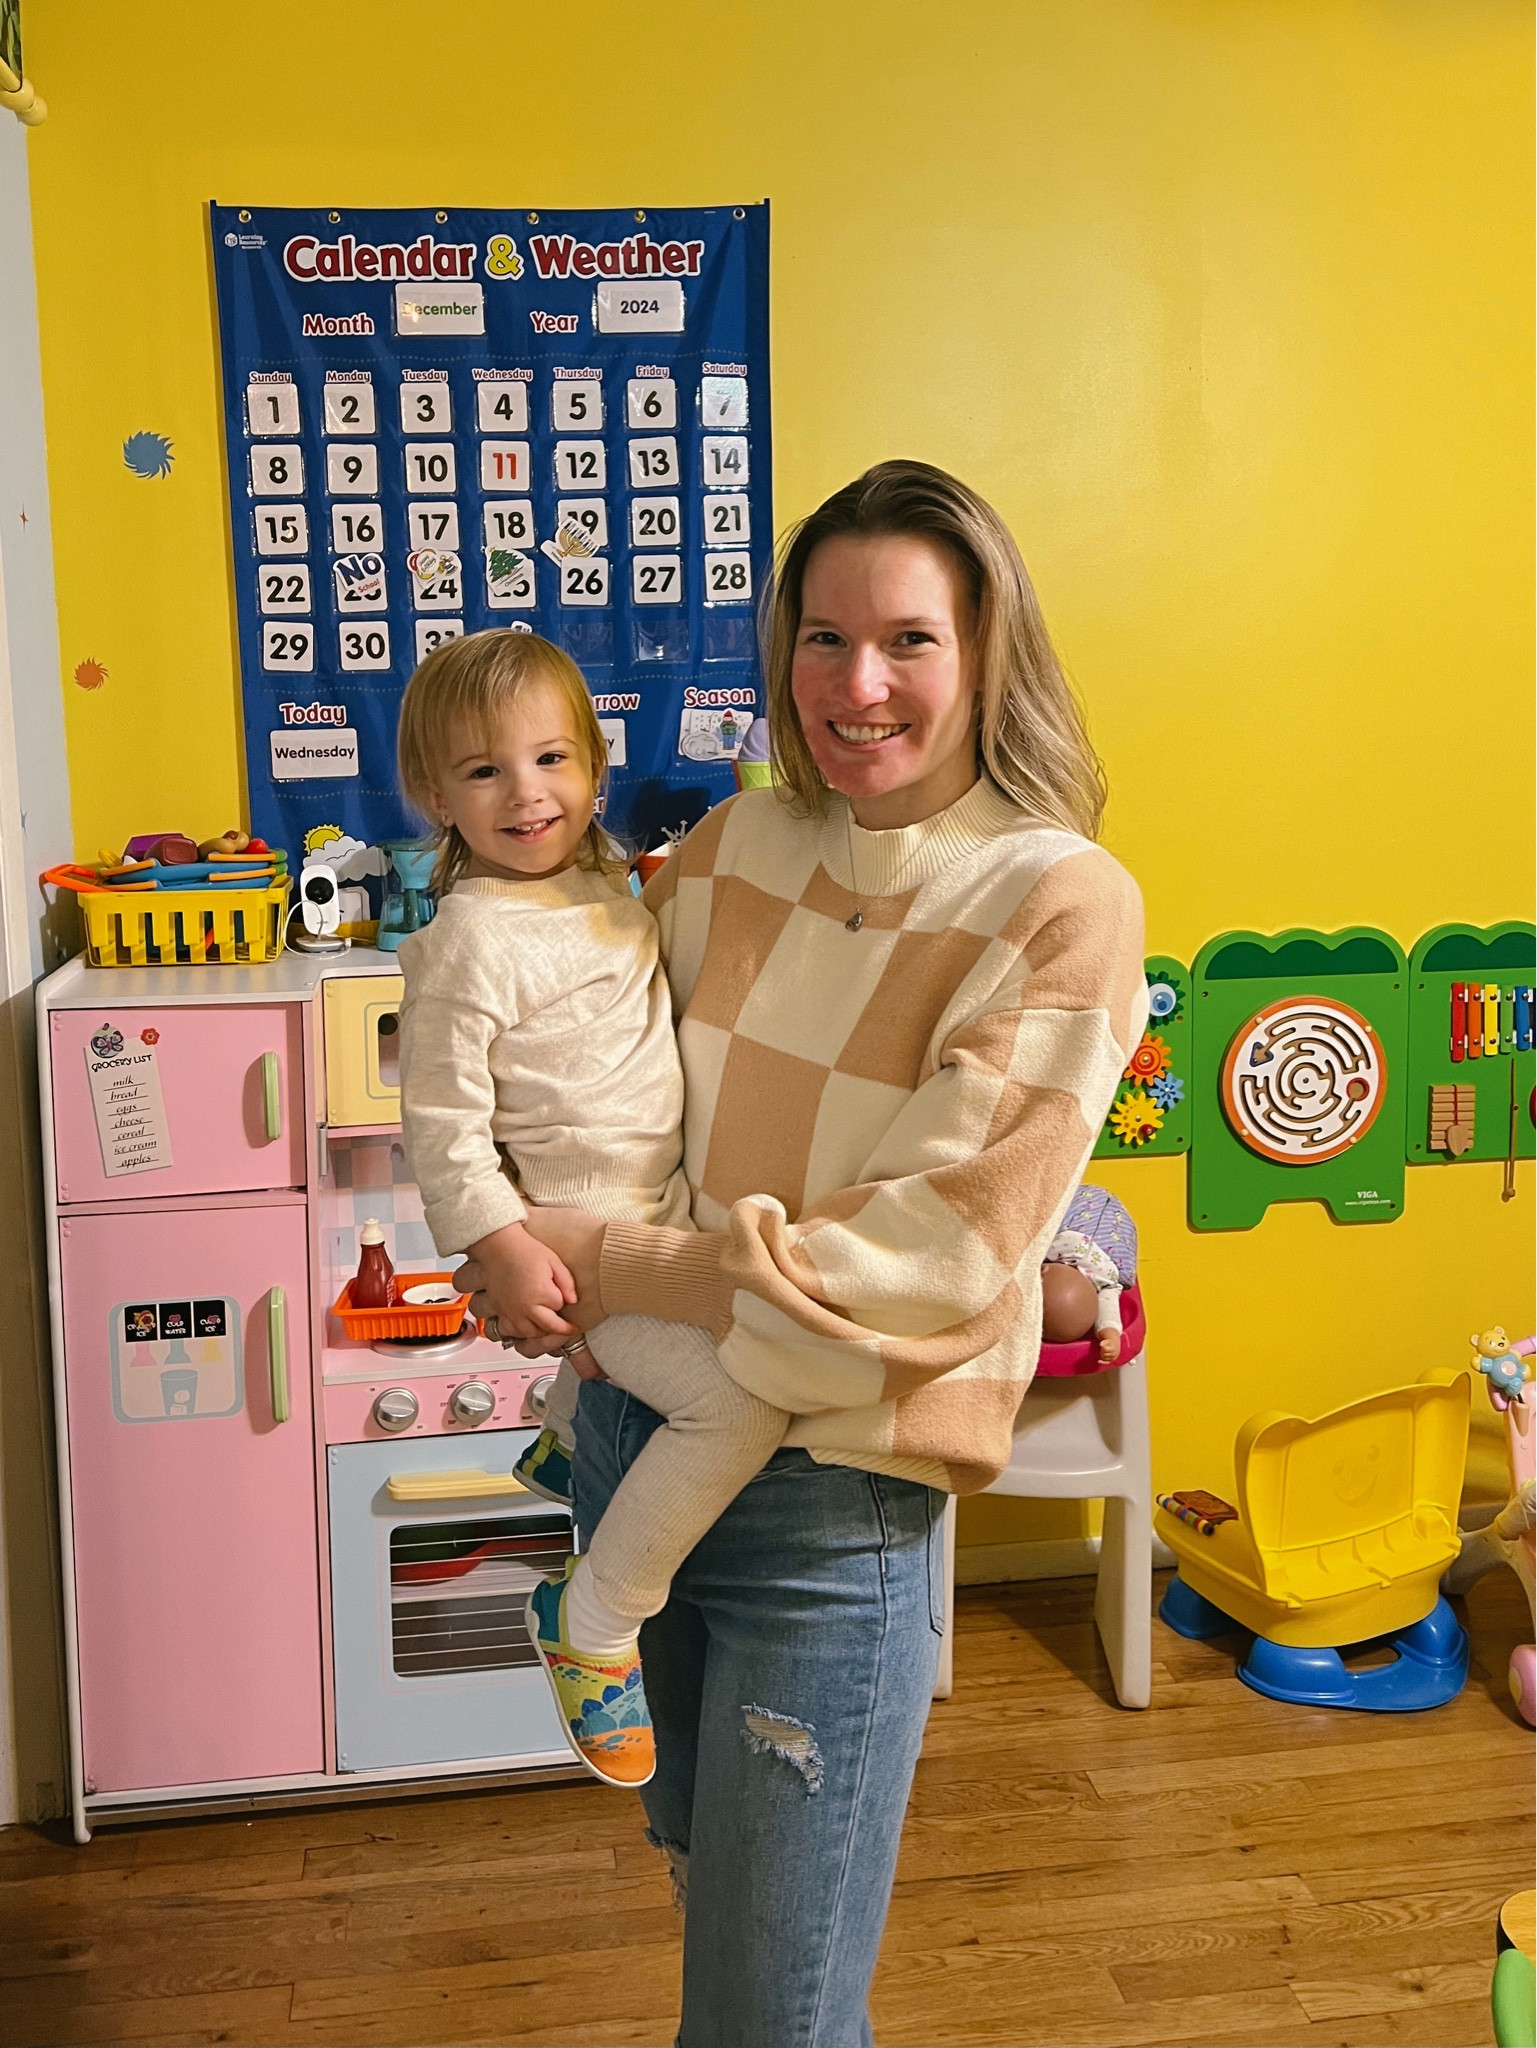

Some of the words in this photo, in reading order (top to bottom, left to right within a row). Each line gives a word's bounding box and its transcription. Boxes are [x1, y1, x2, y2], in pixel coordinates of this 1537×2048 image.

[285, 236, 475, 279] Calendar
[486, 235, 522, 279] &
[531, 235, 703, 277] Weather
[620, 300, 660, 314] 2024
[303, 313, 374, 335] Month
[531, 311, 578, 333] Year
[250, 372, 291, 384] Sunday
[326, 371, 371, 383] Monday
[403, 370, 448, 383] Tuesday
[472, 369, 533, 380] Wednesday
[554, 368, 602, 379] Thursday
[637, 366, 669, 378] Friday
[703, 363, 747, 376] Saturday
[267, 396, 280, 424] 1
[341, 395, 360, 423] 2
[416, 394, 436, 422] 3
[493, 393, 514, 421] 4
[569, 392, 587, 420] 5
[643, 390, 662, 418] 6
[269, 456, 288, 484] 8
[343, 456, 363, 483] 9
[414, 454, 448, 482] 10
[492, 452, 517, 480] 11
[565, 451, 598, 479] 12
[637, 448, 671, 477] 13
[710, 447, 742, 475] 14
[265, 516, 299, 544] 15
[341, 515, 376, 543] 16
[418, 513, 450, 541] 17
[493, 511, 526, 539] 18
[639, 508, 676, 535] 20
[713, 505, 741, 533] 21
[265, 575, 306, 603] 22
[358, 578, 380, 593] School
[566, 567, 603, 595] 26
[640, 566, 676, 593] 27
[711, 563, 747, 591] 28
[269, 633, 309, 661] 29
[345, 632, 386, 660] 30
[595, 693, 640, 711] rrow
[685, 687, 755, 707] Season
[280, 703, 346, 725] Today
[274, 745, 355, 760] Wednesday
[91, 1057, 132, 1073] GROCERY
[133, 1054, 152, 1064] LIST
[110, 1087, 138, 1101] bread
[113, 1074, 134, 1087] milk
[114, 1117, 144, 1128] cheese
[116, 1104, 137, 1116] eggs
[117, 1126, 145, 1140] cereal
[114, 1146, 126, 1154] ice
[129, 1141, 157, 1152] cream
[121, 1153, 151, 1168] apples
[1356, 1190, 1379, 1199] VIGA
[166, 1320, 184, 1328] COLD
